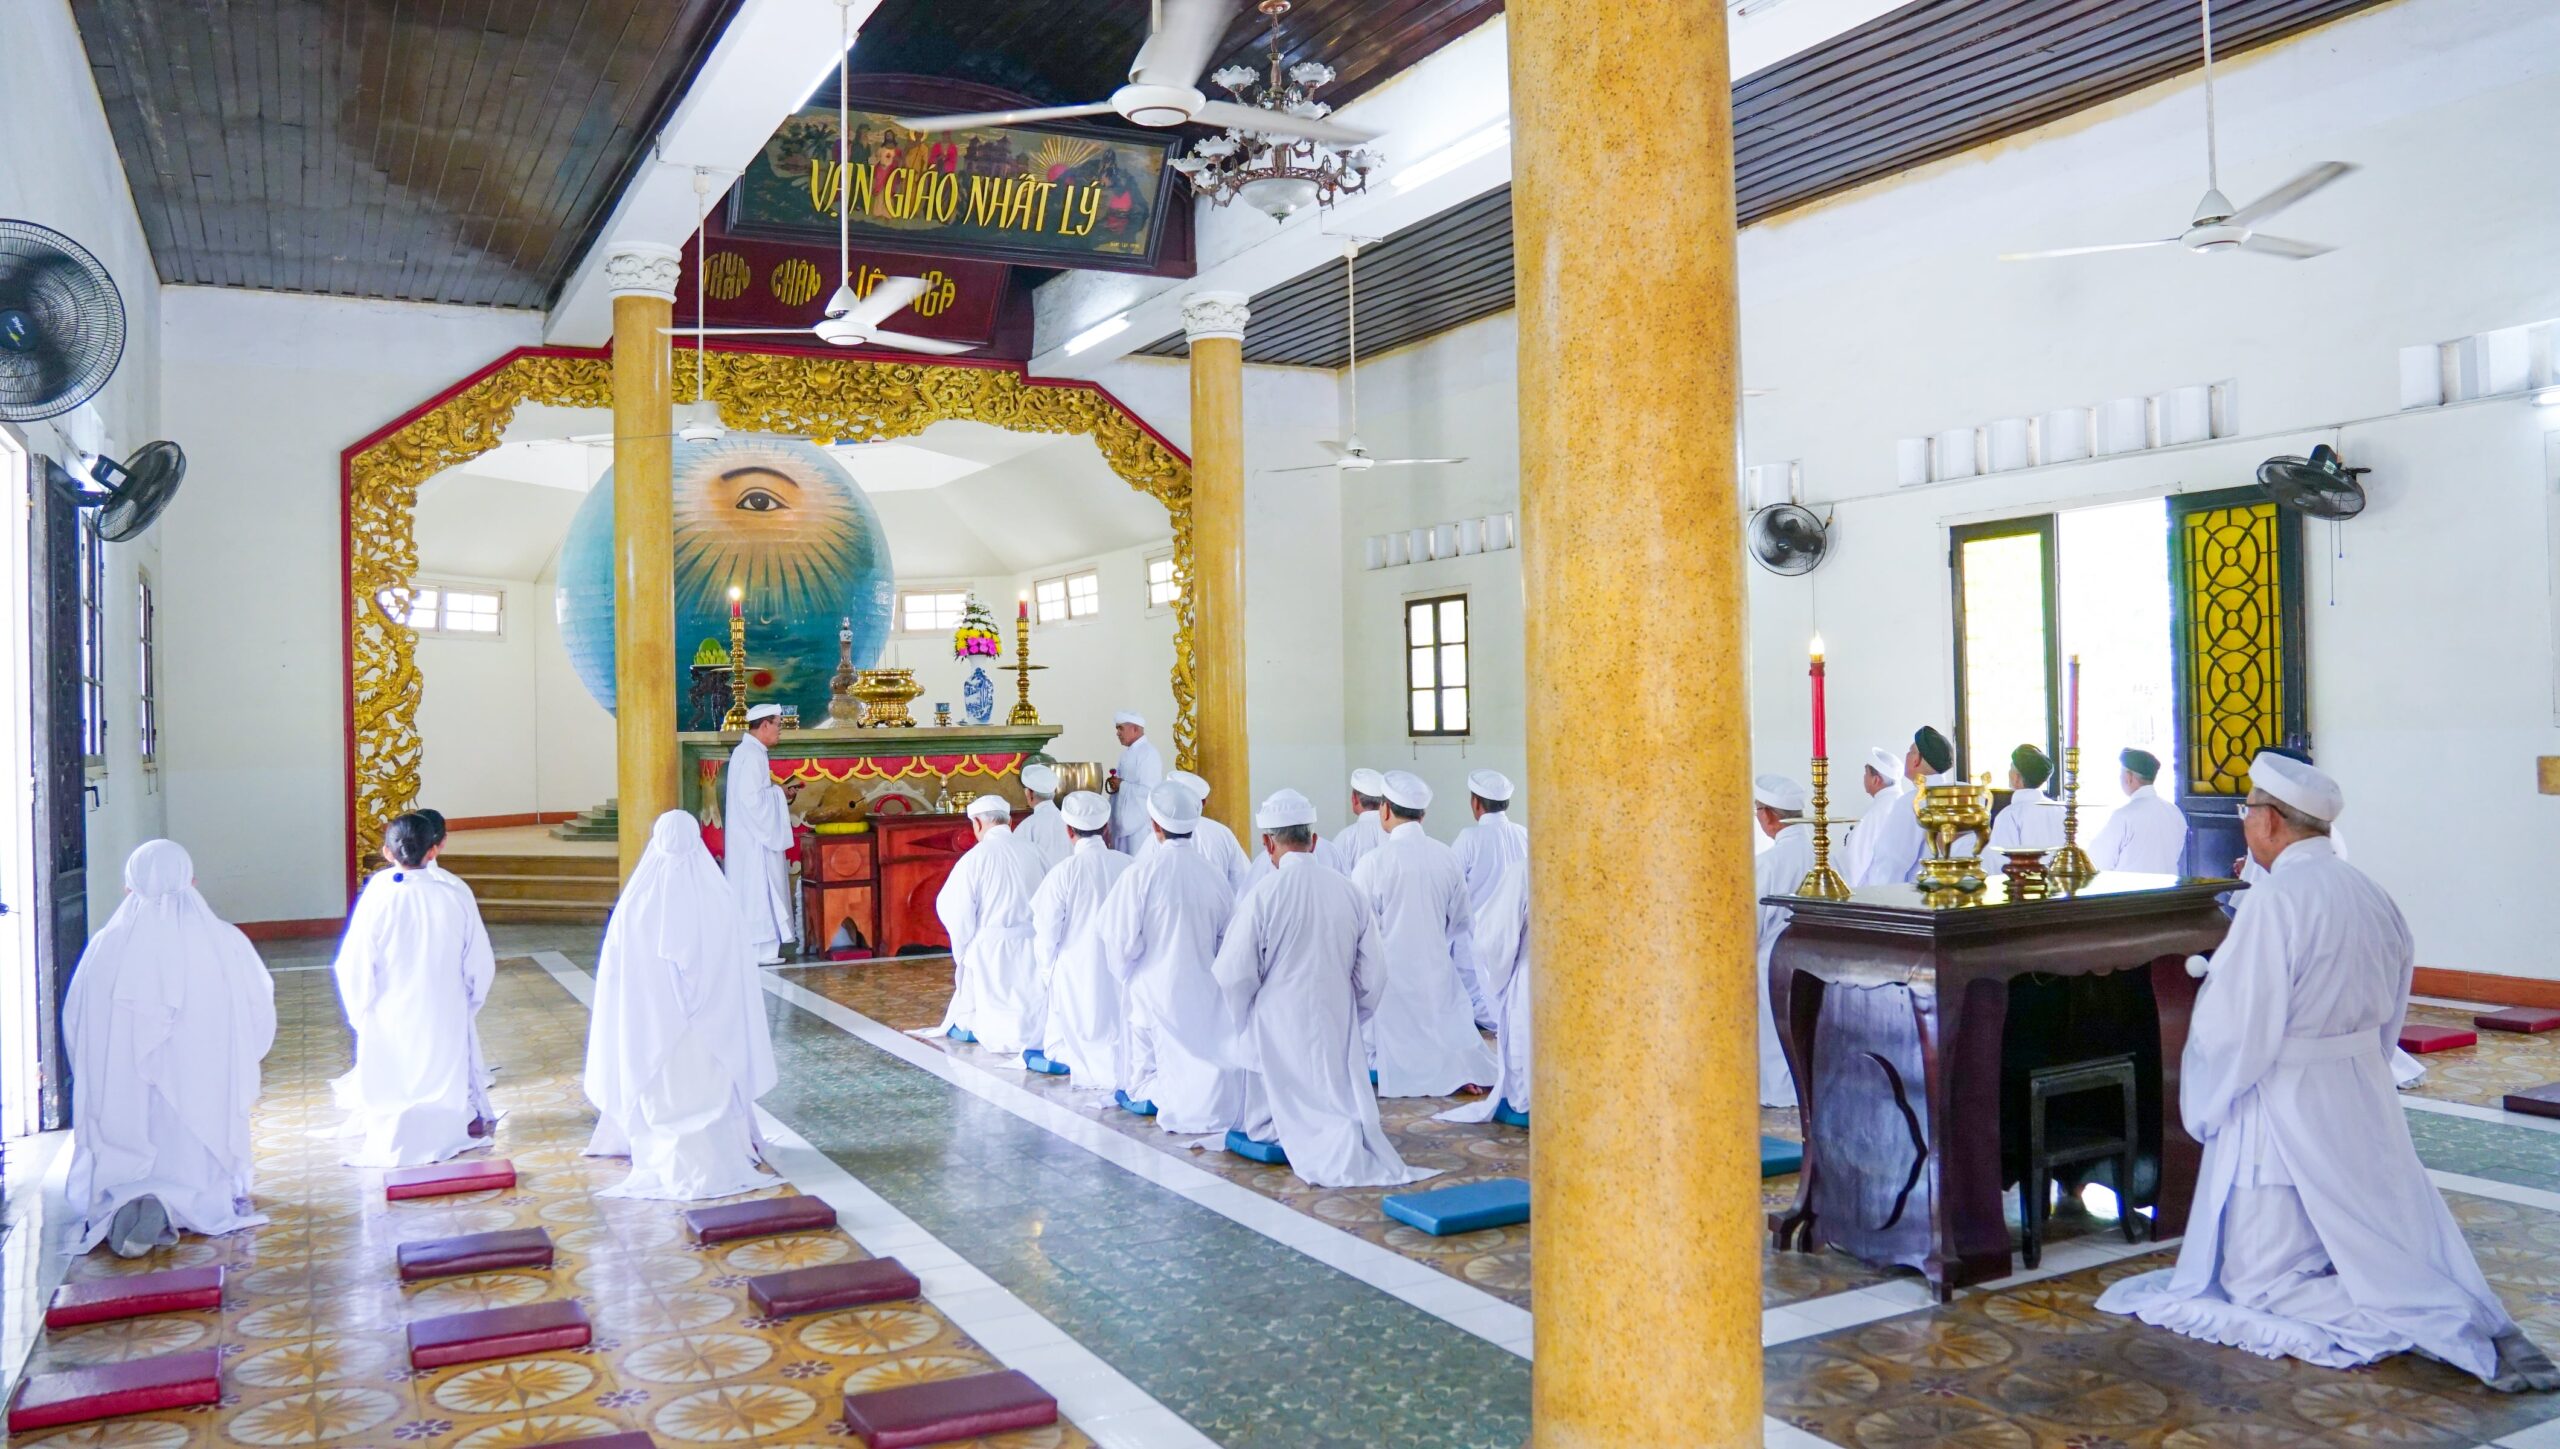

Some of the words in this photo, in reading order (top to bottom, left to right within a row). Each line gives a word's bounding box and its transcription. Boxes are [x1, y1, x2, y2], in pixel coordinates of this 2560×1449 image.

[810, 158, 875, 218] VẠN
[884, 164, 959, 222] GIÁO
[962, 173, 1058, 232] NHẤT
[1057, 181, 1101, 236] LÝ
[770, 258, 822, 306] CHÂN
